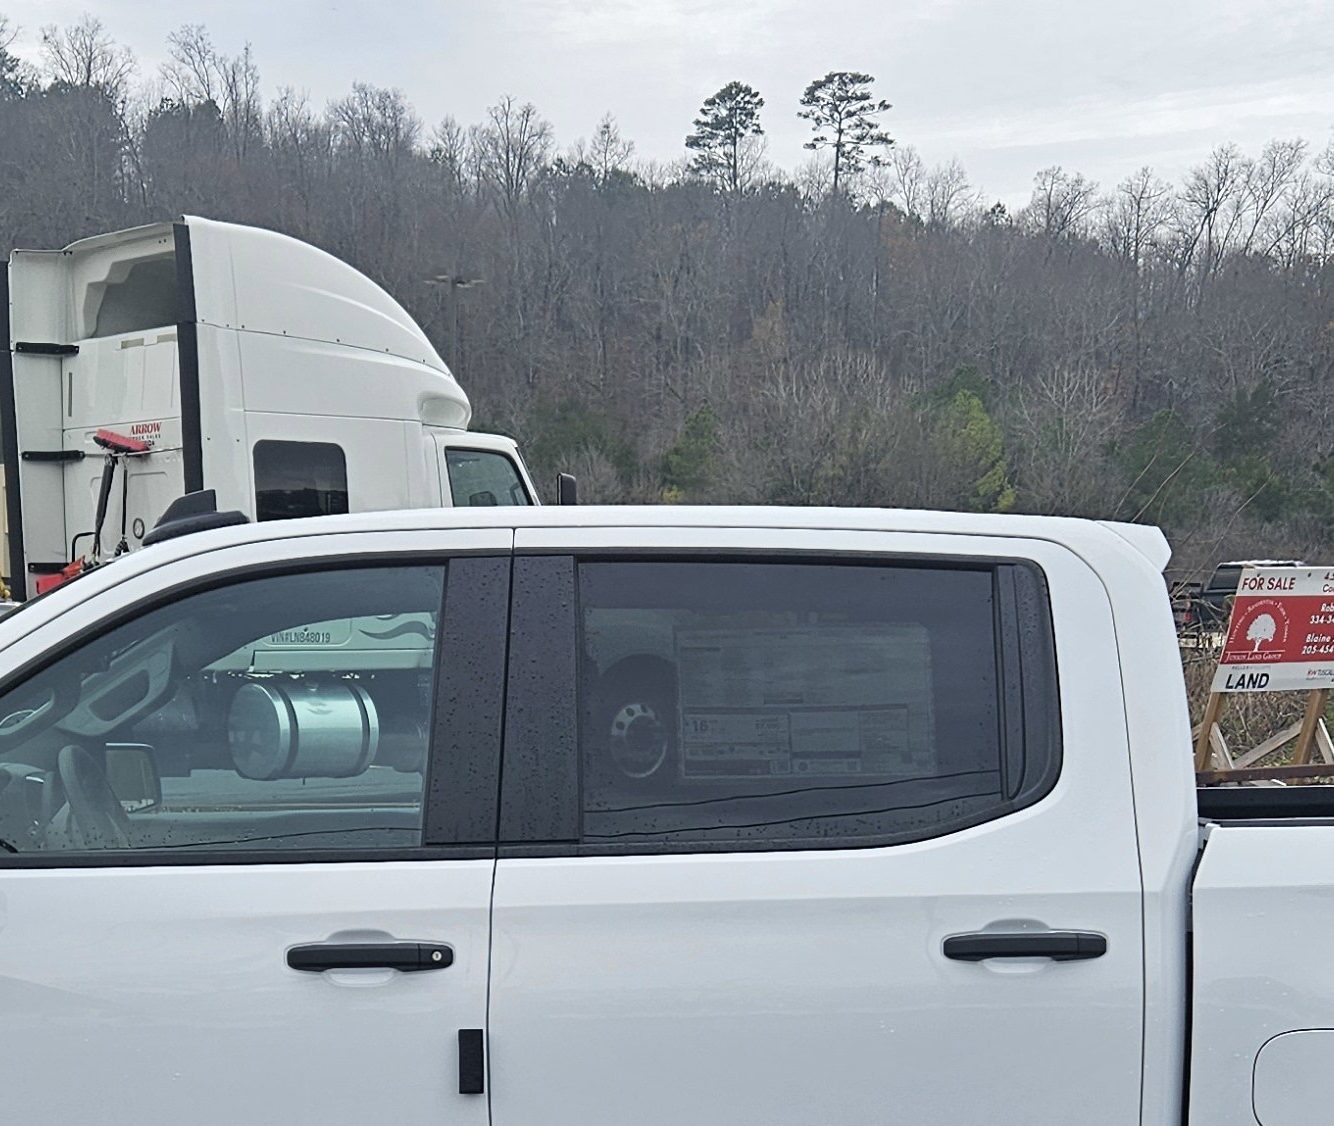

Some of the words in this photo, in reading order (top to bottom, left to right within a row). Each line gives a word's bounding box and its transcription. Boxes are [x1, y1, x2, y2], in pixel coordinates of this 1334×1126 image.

[130, 422, 162, 435] ARROW
[1241, 577, 1264, 591] FOR
[1267, 577, 1296, 591] SALE
[1320, 602, 1334, 612] Rob
[271, 632, 331, 644] VIN#LN848019
[1306, 633, 1331, 643] Blaine
[1225, 673, 1270, 689] LAND
